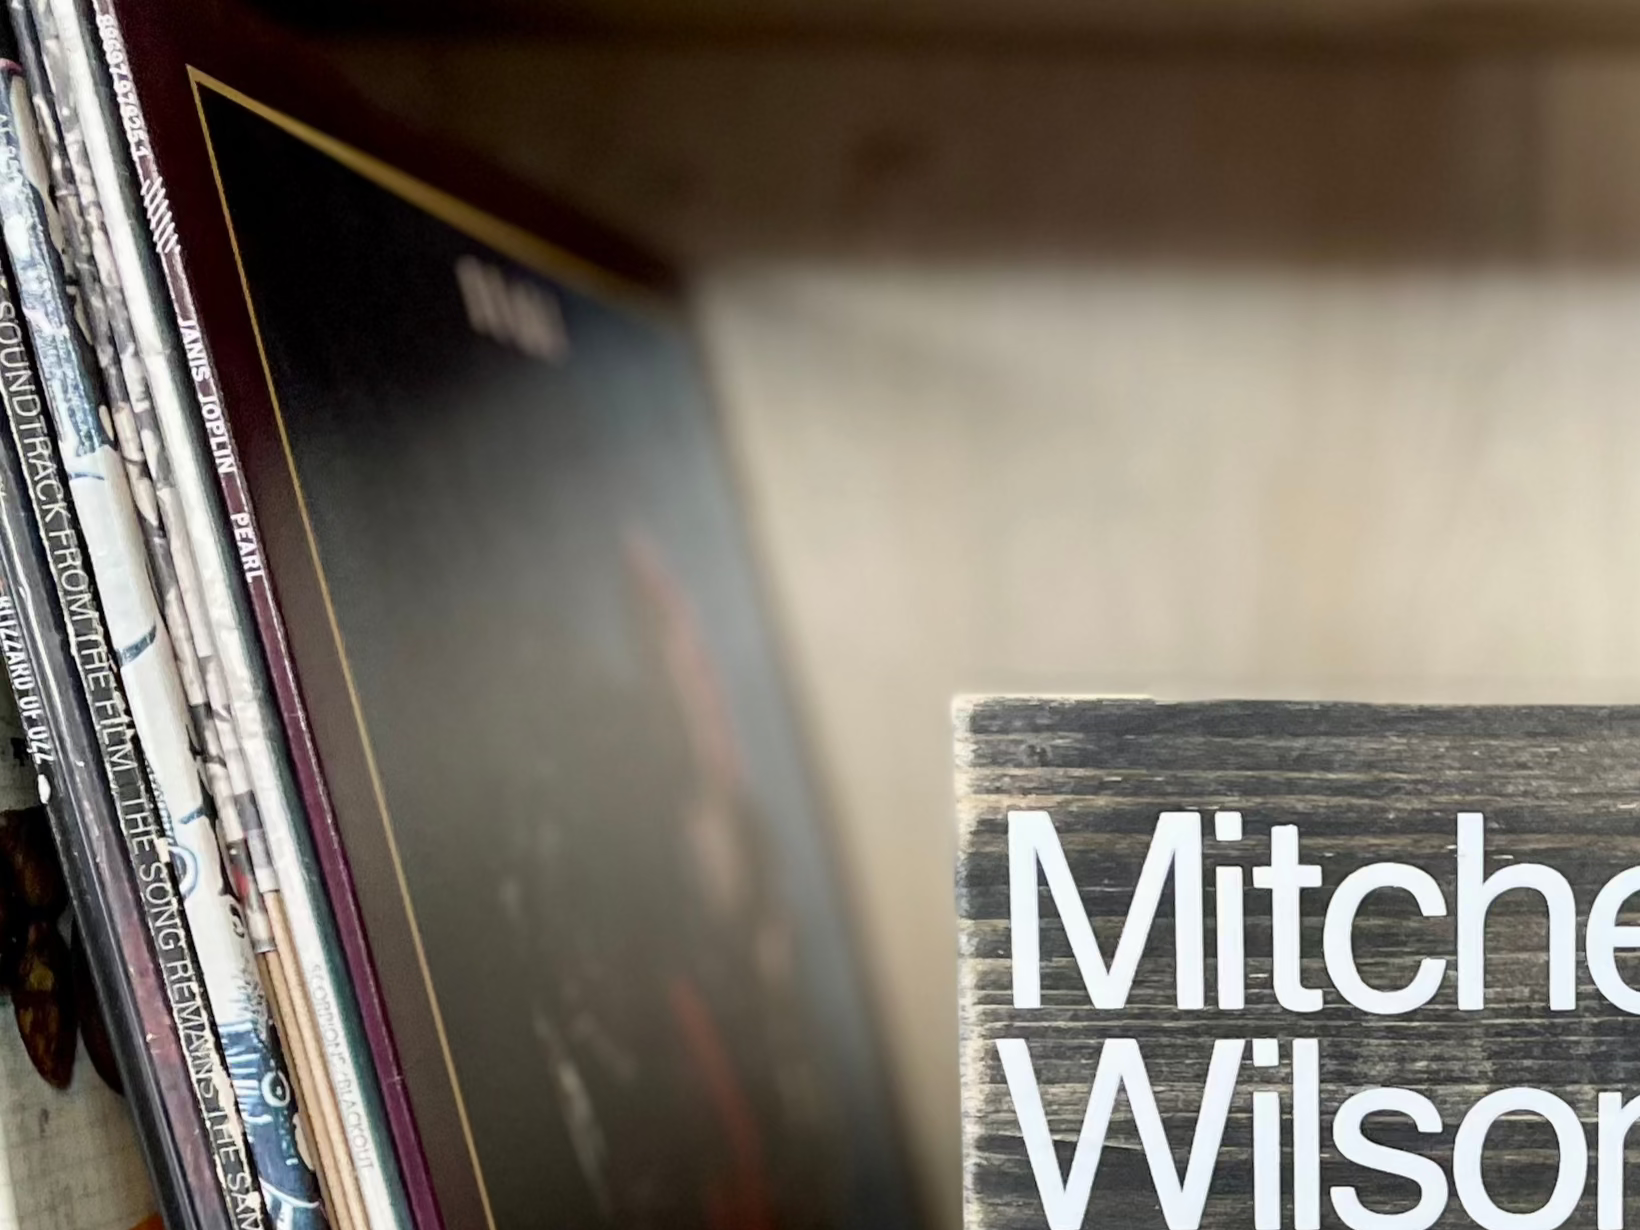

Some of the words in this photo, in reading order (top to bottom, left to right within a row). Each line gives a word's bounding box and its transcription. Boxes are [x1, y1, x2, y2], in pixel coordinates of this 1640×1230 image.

[0, 297, 71, 523] SOUNDTRACK
[177, 314, 211, 382] JANIS
[198, 392, 237, 475] JOPLIN
[229, 511, 265, 582] PEARL
[48, 526, 95, 623] FROM
[75, 631, 115, 691] THE
[18, 694, 42, 721] OF
[27, 724, 54, 765] OZZ
[93, 696, 135, 774] FILM
[119, 793, 158, 855] THE
[136, 858, 186, 952] SONG
[162, 957, 226, 1100] REMAINS
[207, 1108, 243, 1165] THE
